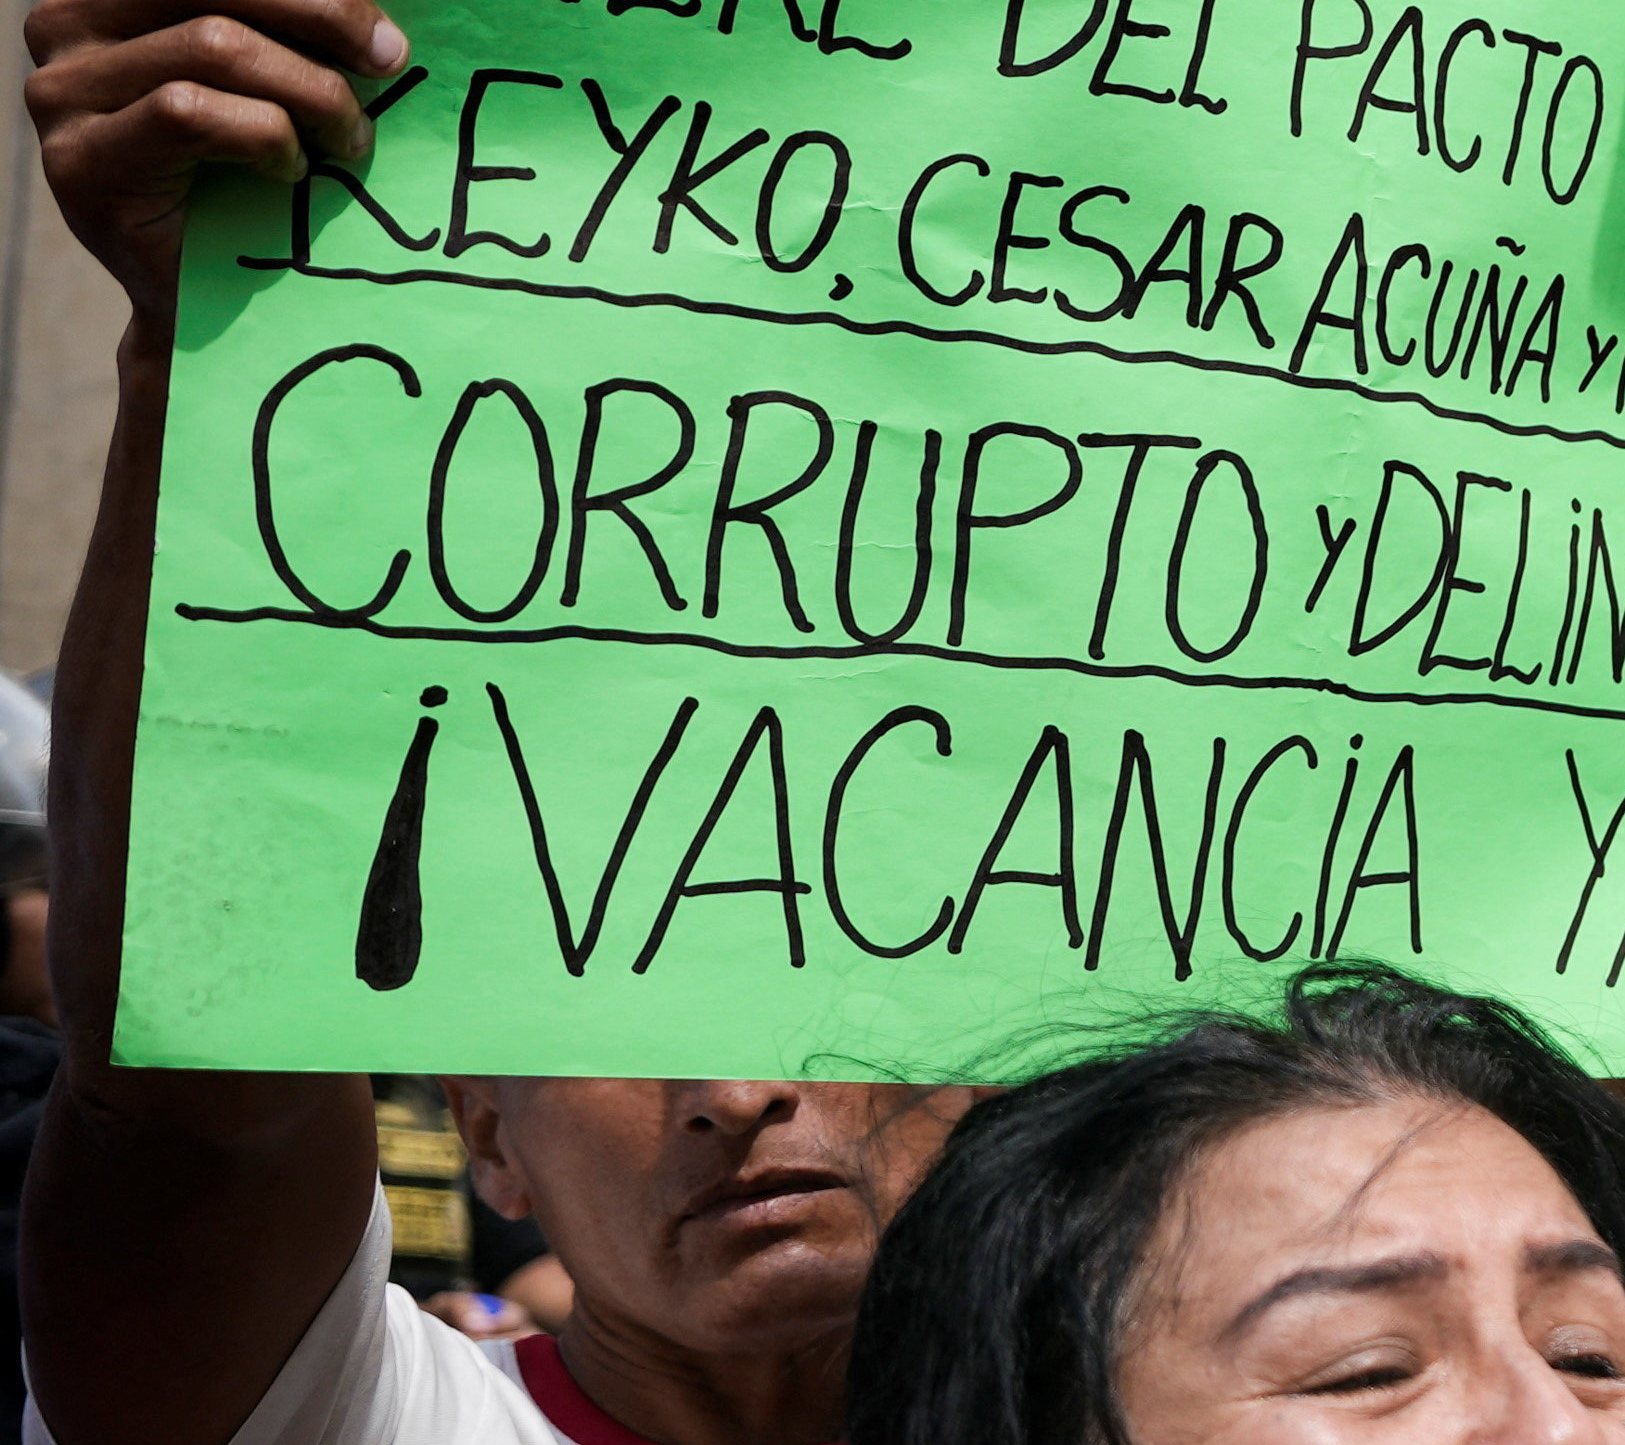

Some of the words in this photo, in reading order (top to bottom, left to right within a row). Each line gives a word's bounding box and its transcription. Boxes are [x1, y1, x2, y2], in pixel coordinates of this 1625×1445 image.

[898, 154, 1283, 336] CESAR
[1290, 216, 1564, 403] ACUÑA
[252, 346, 1268, 663] CORRUPTO
